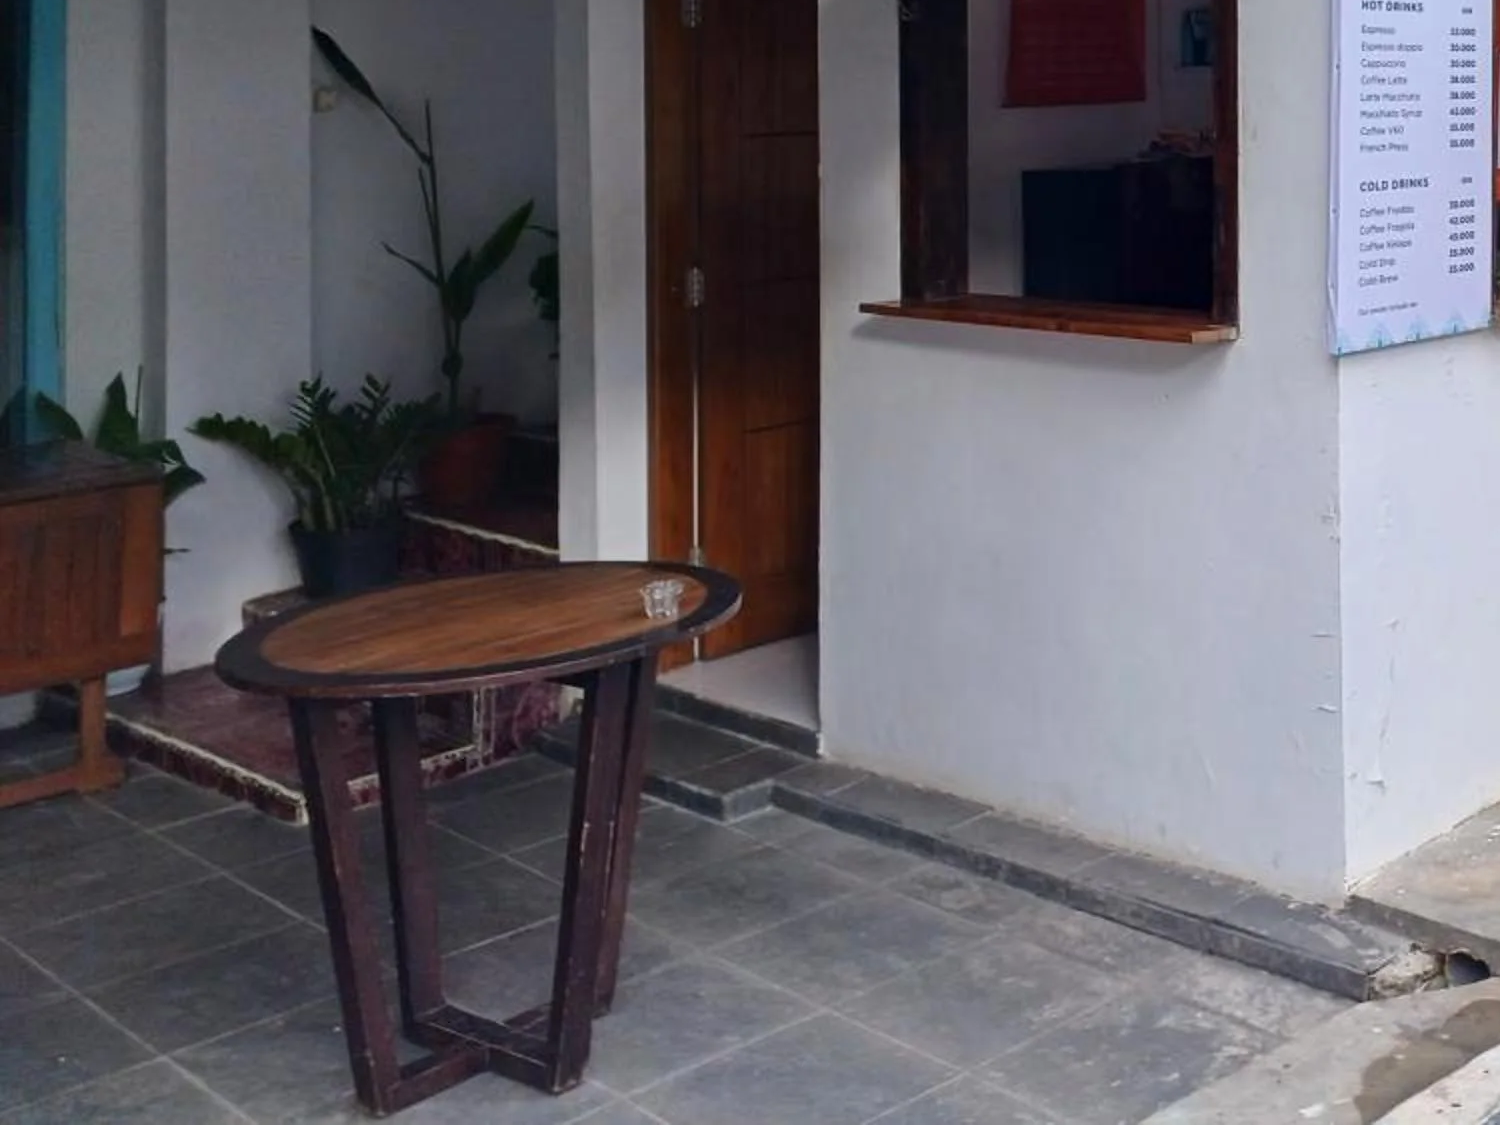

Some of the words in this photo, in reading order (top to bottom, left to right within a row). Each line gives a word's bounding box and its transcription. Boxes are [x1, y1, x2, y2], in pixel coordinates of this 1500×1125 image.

[1361, 0, 1385, 11] HOT
[1385, 1, 1424, 13] DRINKS
[1359, 180, 1389, 192] COLD
[1391, 178, 1429, 190] DRINKS
